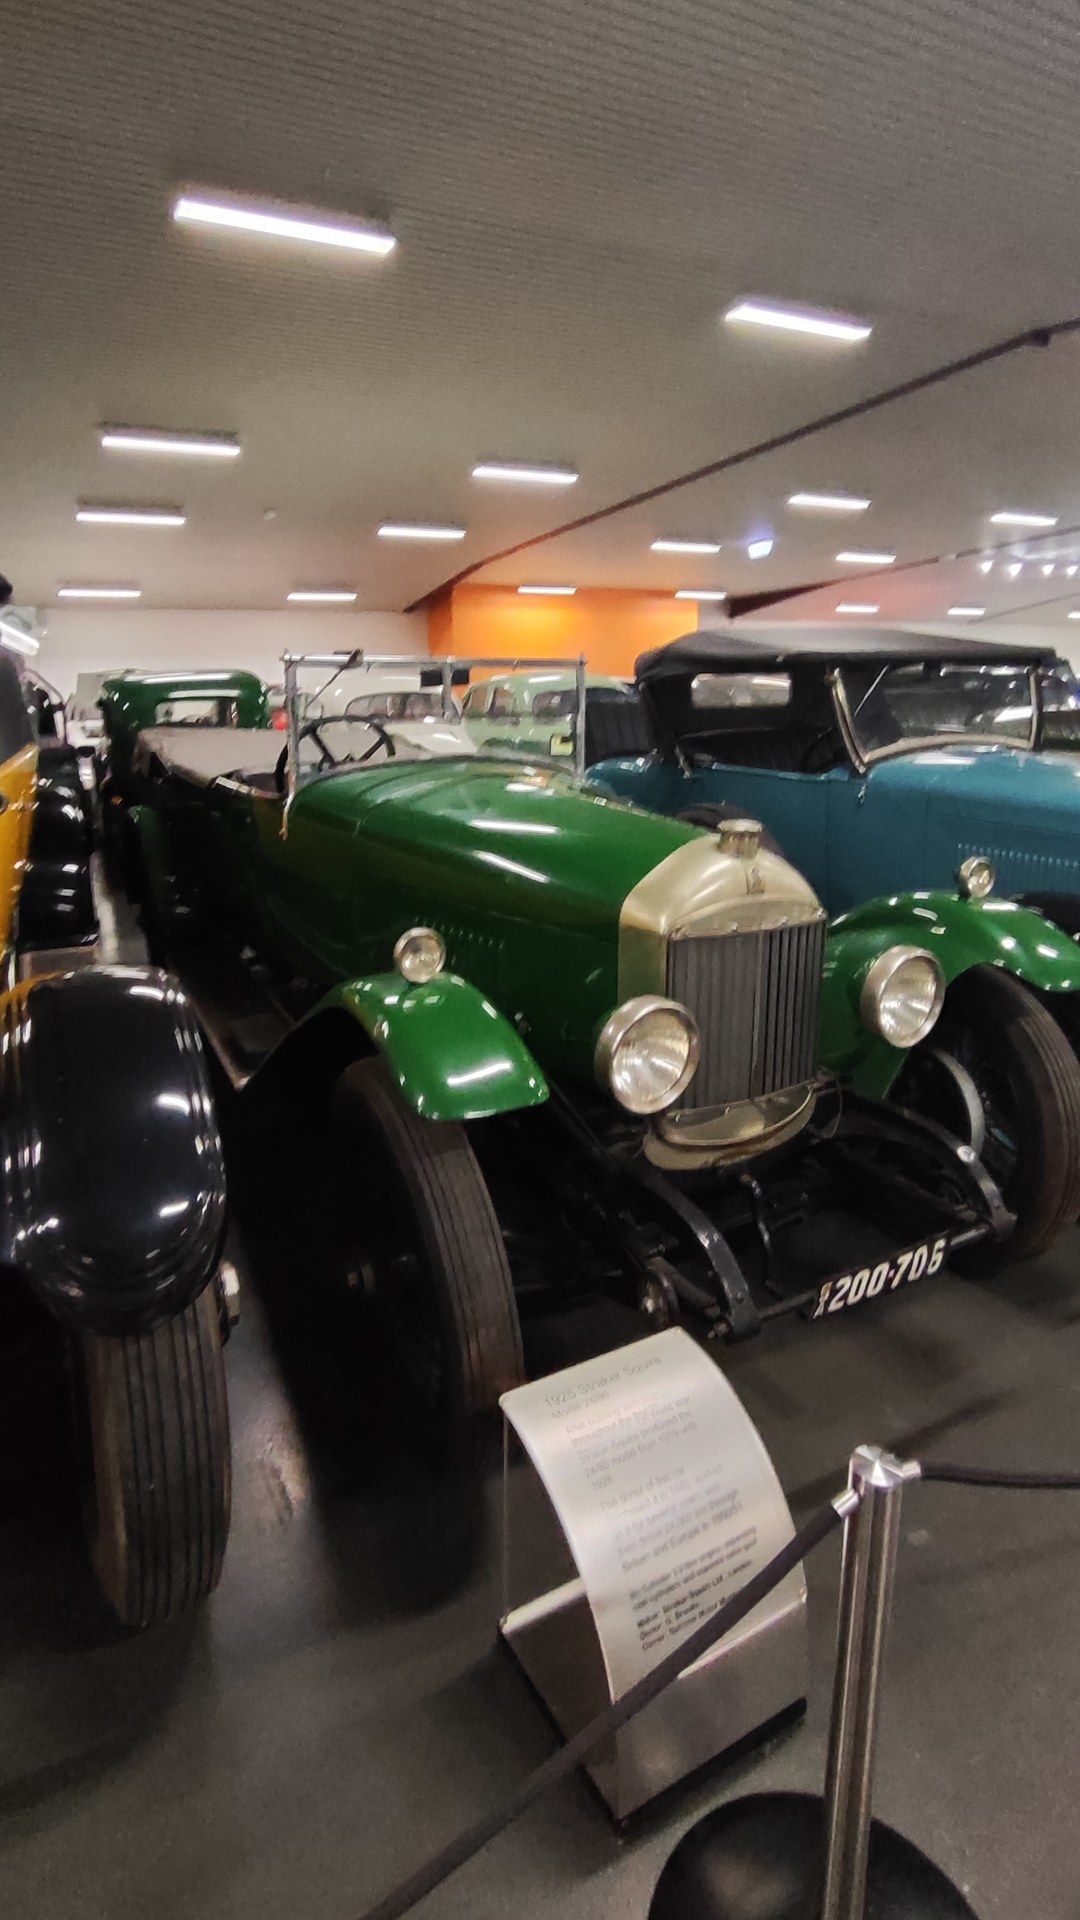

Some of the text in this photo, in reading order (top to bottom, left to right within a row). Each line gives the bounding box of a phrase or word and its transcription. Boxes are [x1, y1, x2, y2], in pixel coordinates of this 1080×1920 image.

[544, 1355, 661, 1407] 1925 Straker Squire
